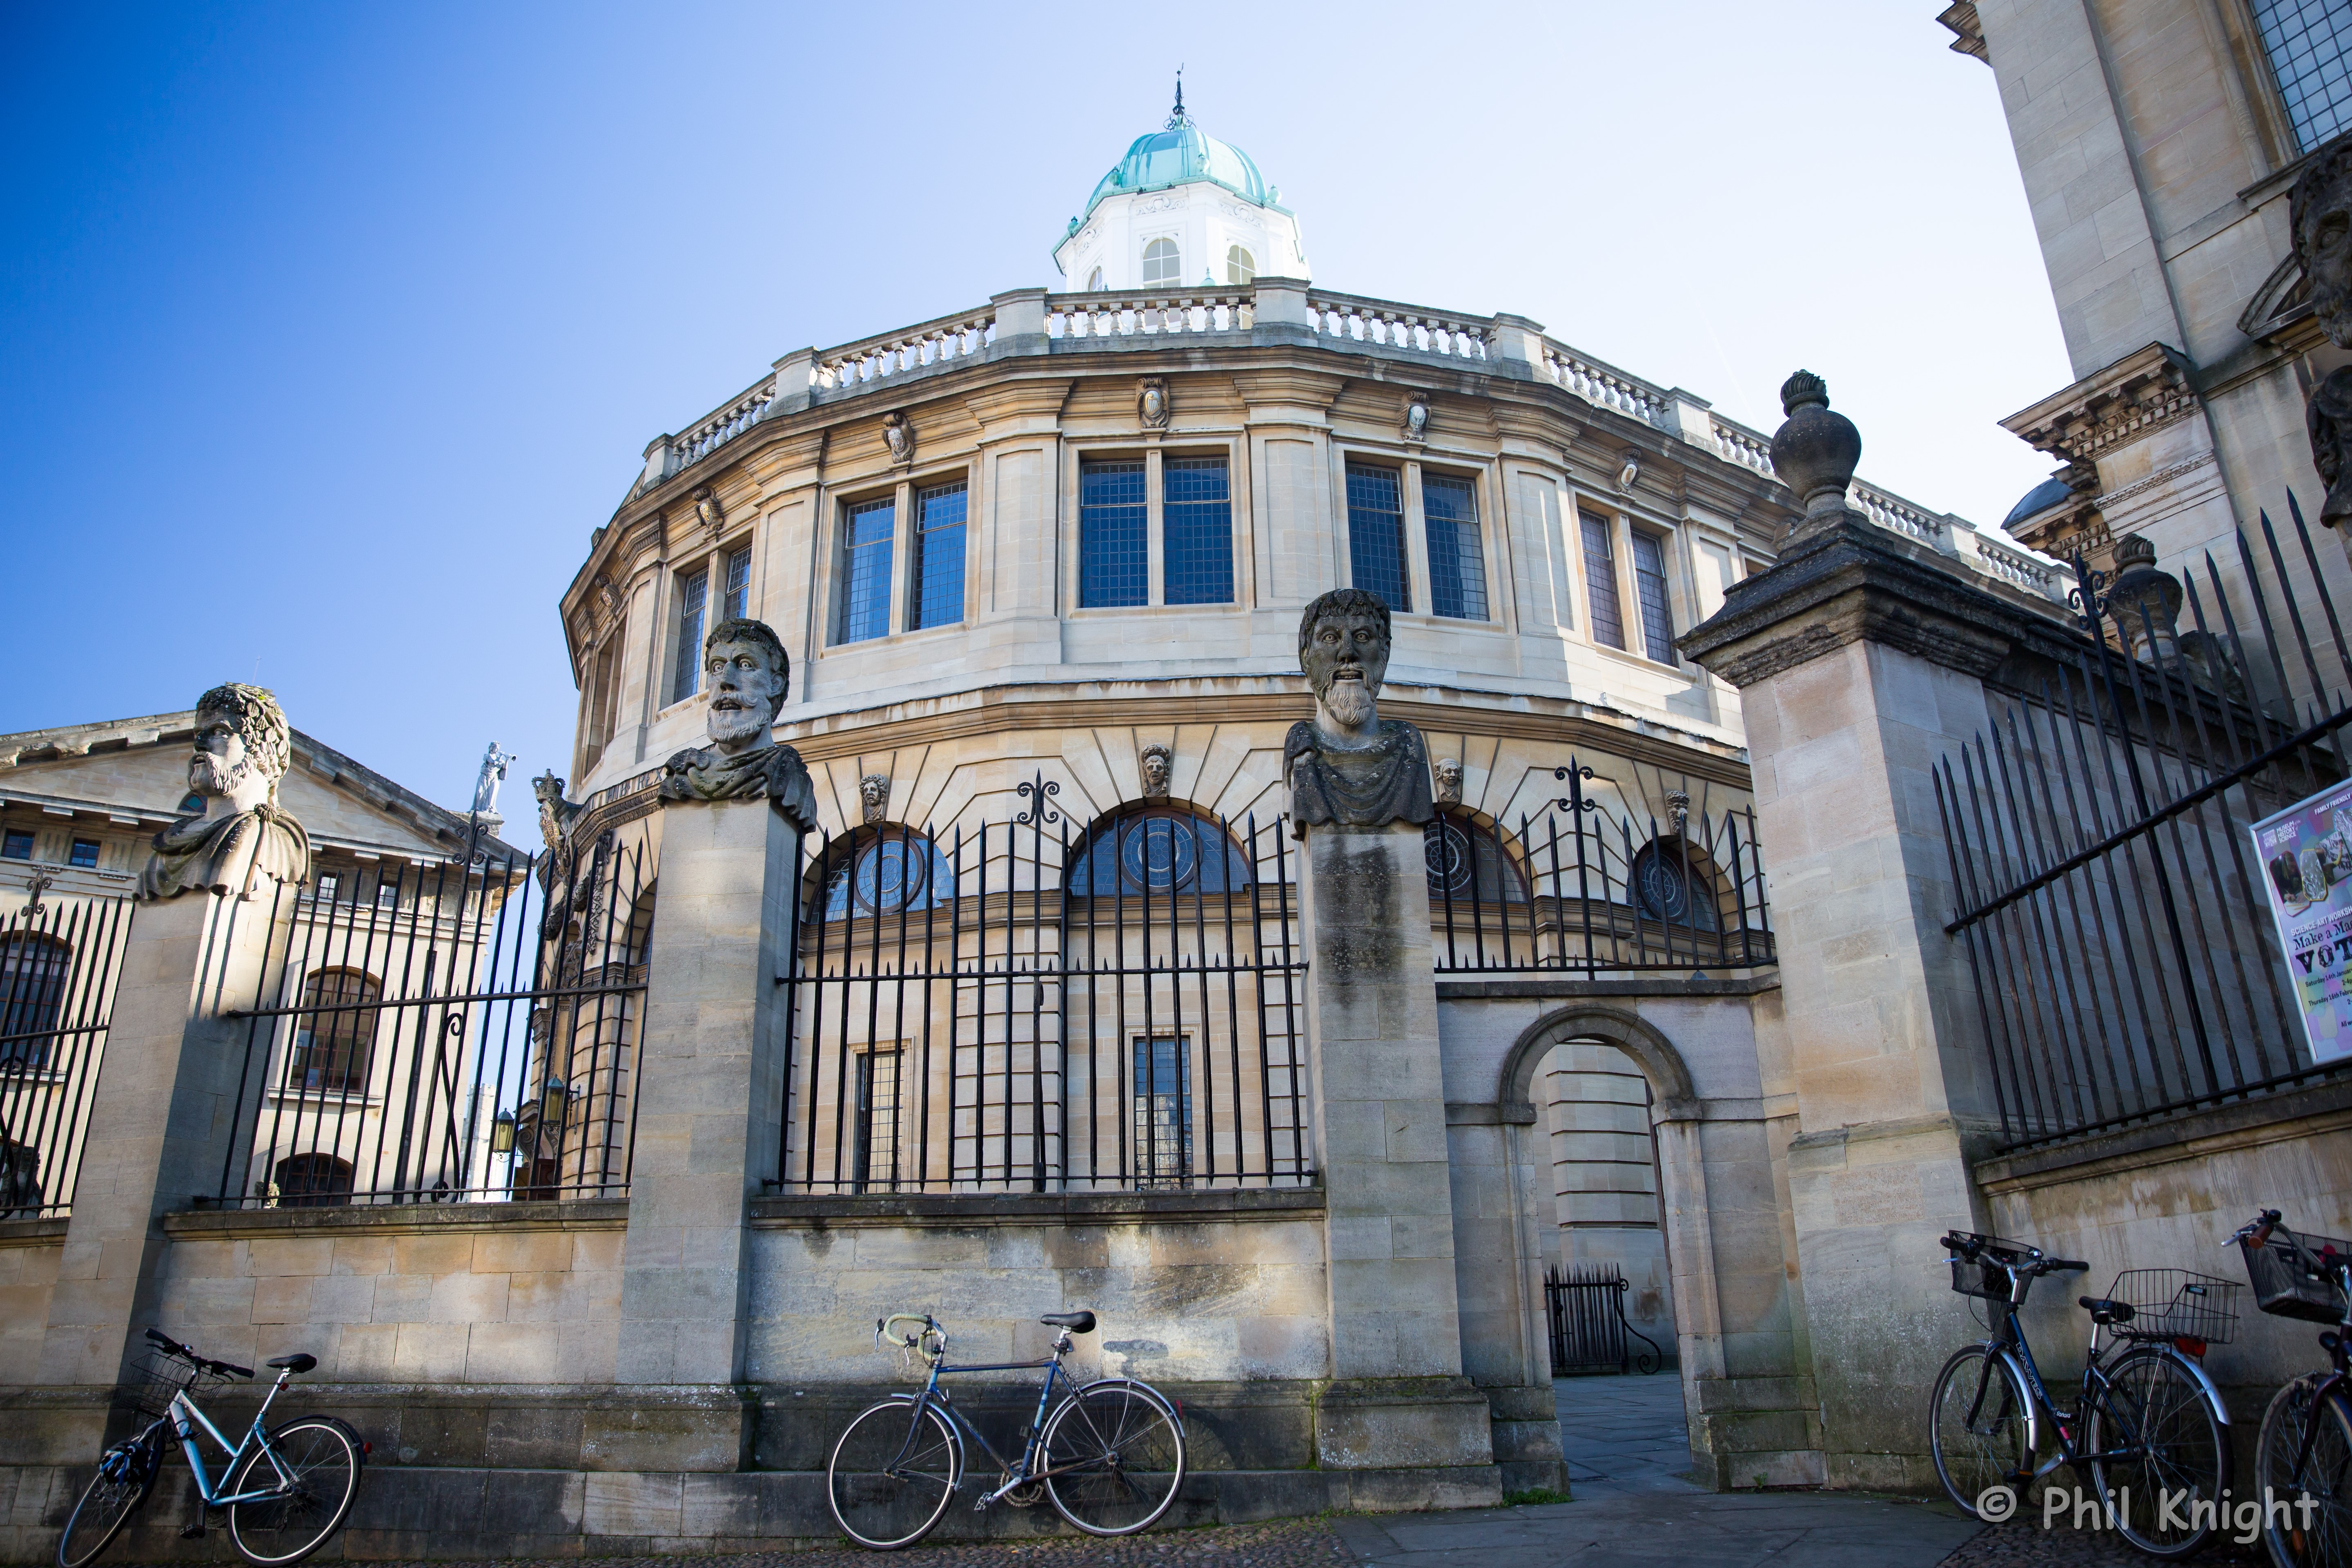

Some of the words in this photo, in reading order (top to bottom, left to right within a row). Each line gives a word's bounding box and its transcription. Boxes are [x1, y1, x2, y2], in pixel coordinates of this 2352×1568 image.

[637, 767, 664, 790] REX
[2314, 803, 2330, 815] FAMILY
[2330, 793, 2350, 808] FRIENDLY
[2276, 820, 2294, 834] MUSEUM
[2278, 826, 2294, 838] HISTORY
[2279, 831, 2296, 843] SCIENCE
[2293, 933, 2324, 950] Make
[2325, 930, 2332, 939] a
[2305, 978, 2325, 987] Saturday
[2308, 997, 2328, 1007] Thursday
[2329, 992, 2339, 1000] 16th
[2016, 1341, 2042, 1400] DAWES
